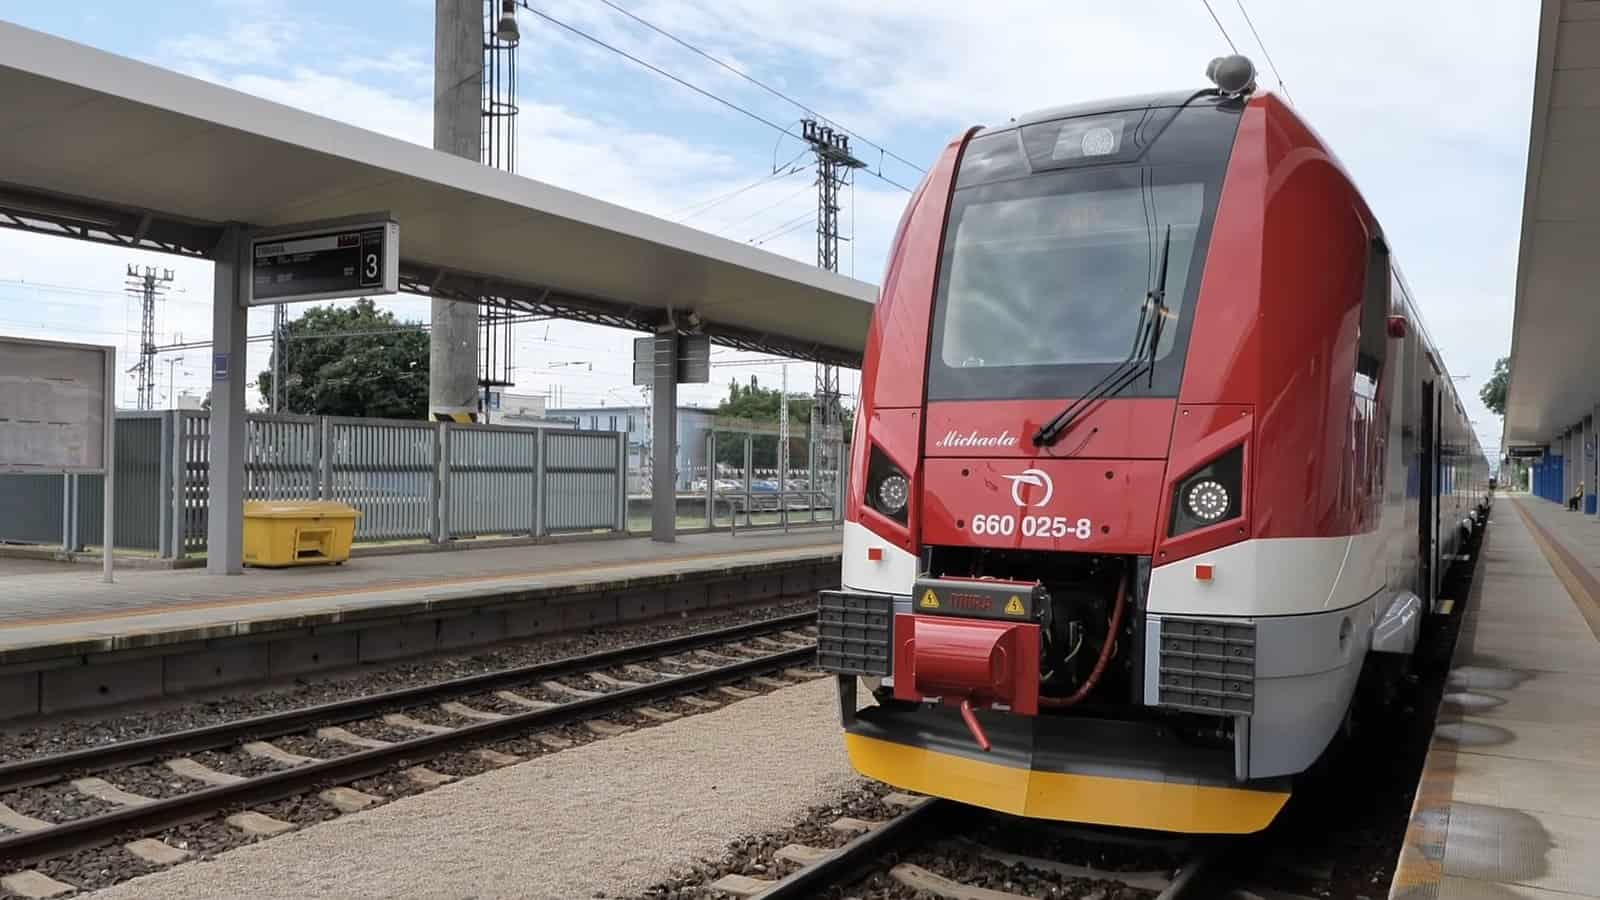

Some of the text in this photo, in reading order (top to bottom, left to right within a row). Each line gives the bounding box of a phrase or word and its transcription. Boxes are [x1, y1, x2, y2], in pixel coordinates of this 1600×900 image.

[366, 254, 378, 278] 3
[935, 430, 1017, 448] Michaela
[972, 514, 1091, 539] 660 025-8
